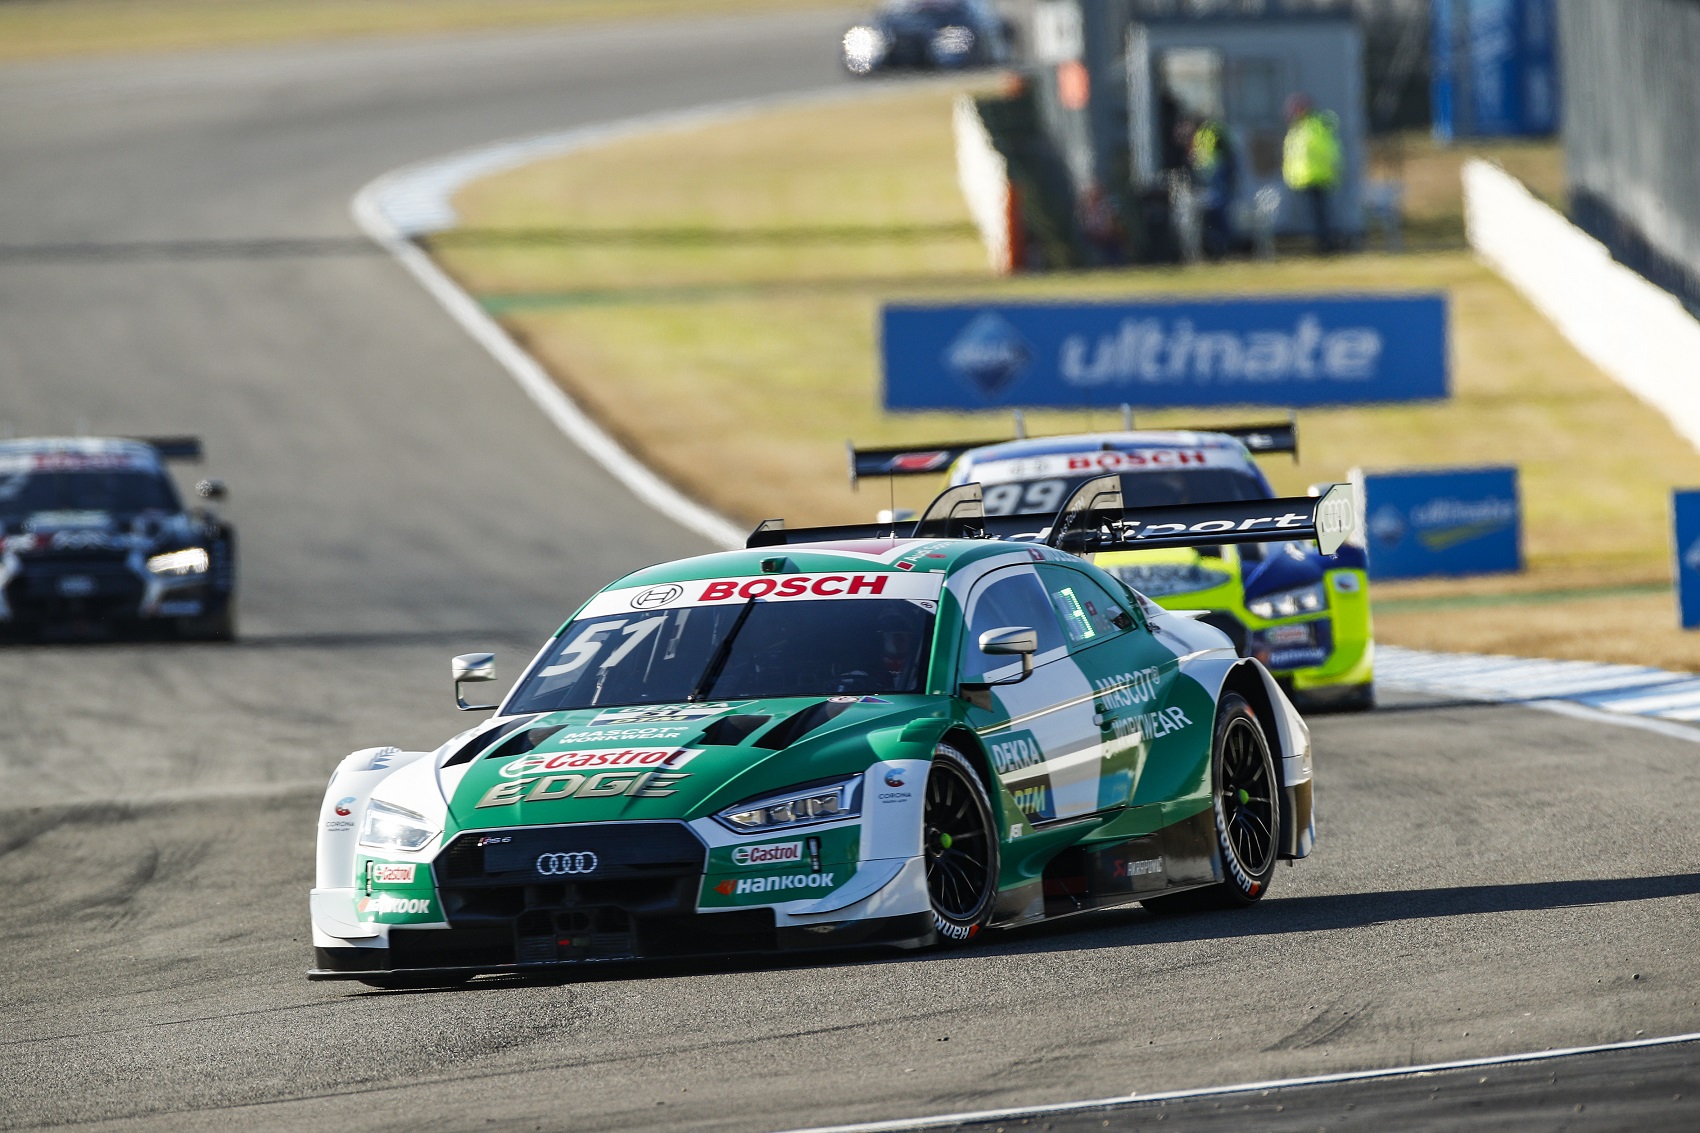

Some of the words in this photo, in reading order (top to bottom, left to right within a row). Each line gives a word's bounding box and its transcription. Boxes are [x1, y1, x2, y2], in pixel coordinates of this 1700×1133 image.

[1058, 317, 1382, 383] ultimate
[1067, 449, 1206, 473] BOSCH
[983, 480, 1068, 516] 99
[698, 575, 889, 602] BOSCH
[538, 615, 668, 677] 51
[558, 732, 681, 745] WORKWEAR
[544, 749, 688, 770] Castrol
[991, 737, 1042, 775] DEKRA
[474, 771, 695, 810] EDGE
[1013, 784, 1046, 816] DTM
[750, 844, 799, 863] Castrol
[381, 866, 413, 881] Castrol
